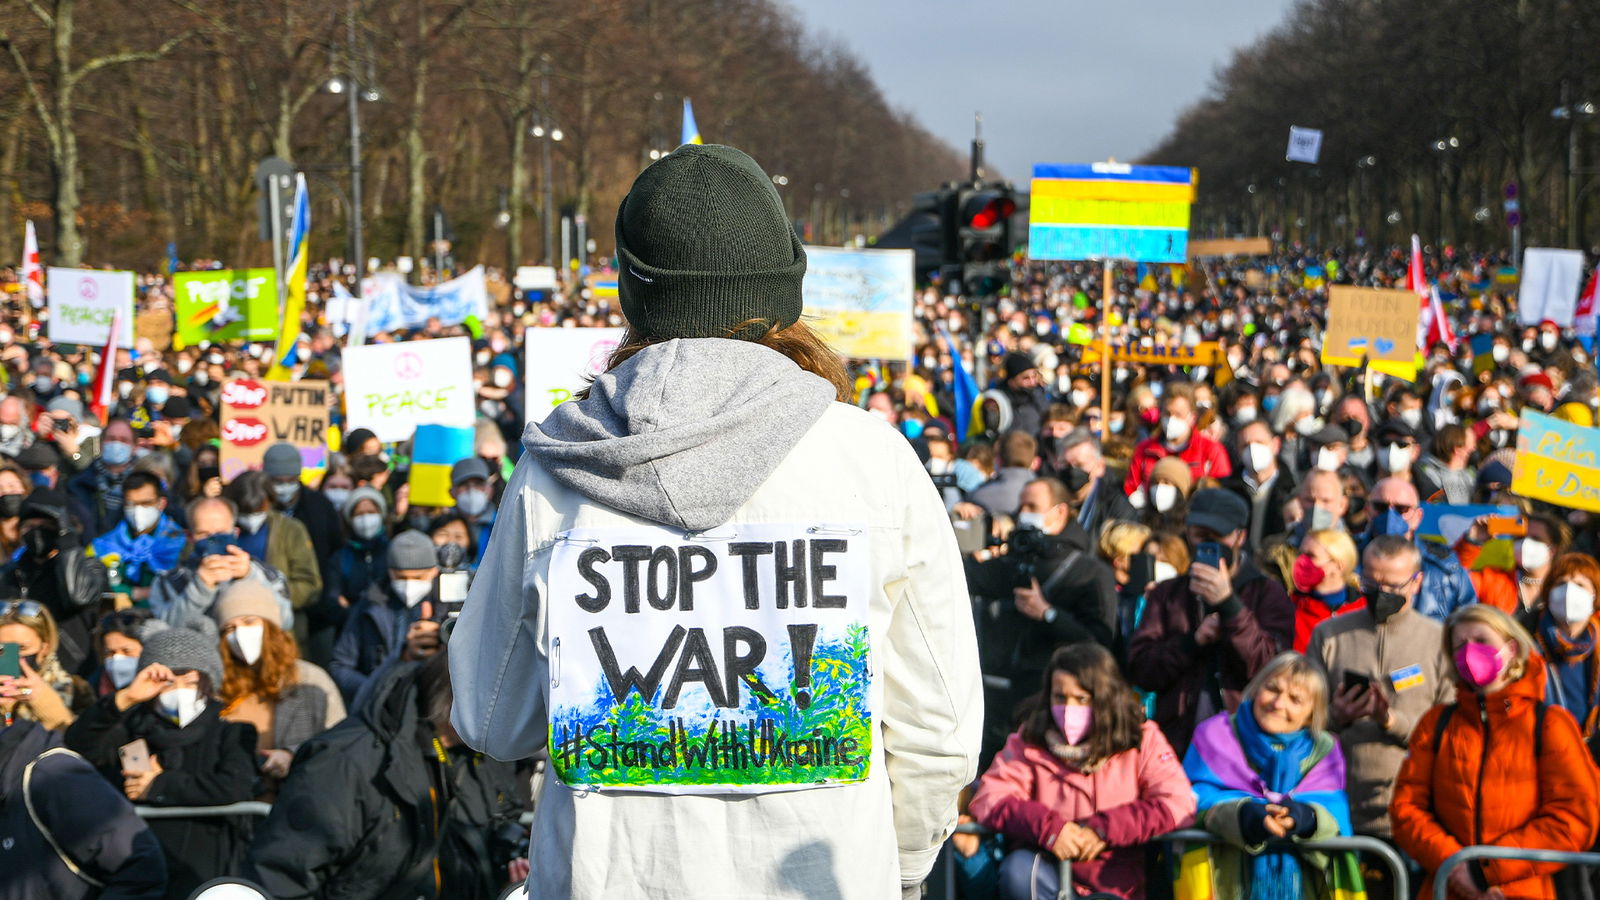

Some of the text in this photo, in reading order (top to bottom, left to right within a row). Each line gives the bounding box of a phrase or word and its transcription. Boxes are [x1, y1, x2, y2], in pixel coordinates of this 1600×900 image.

[184, 277, 267, 304] PEACE
[271, 386, 325, 406] PUTIN
[363, 385, 456, 417] PEACE
[270, 415, 325, 443] WAR
[575, 539, 848, 614] STOP THE
